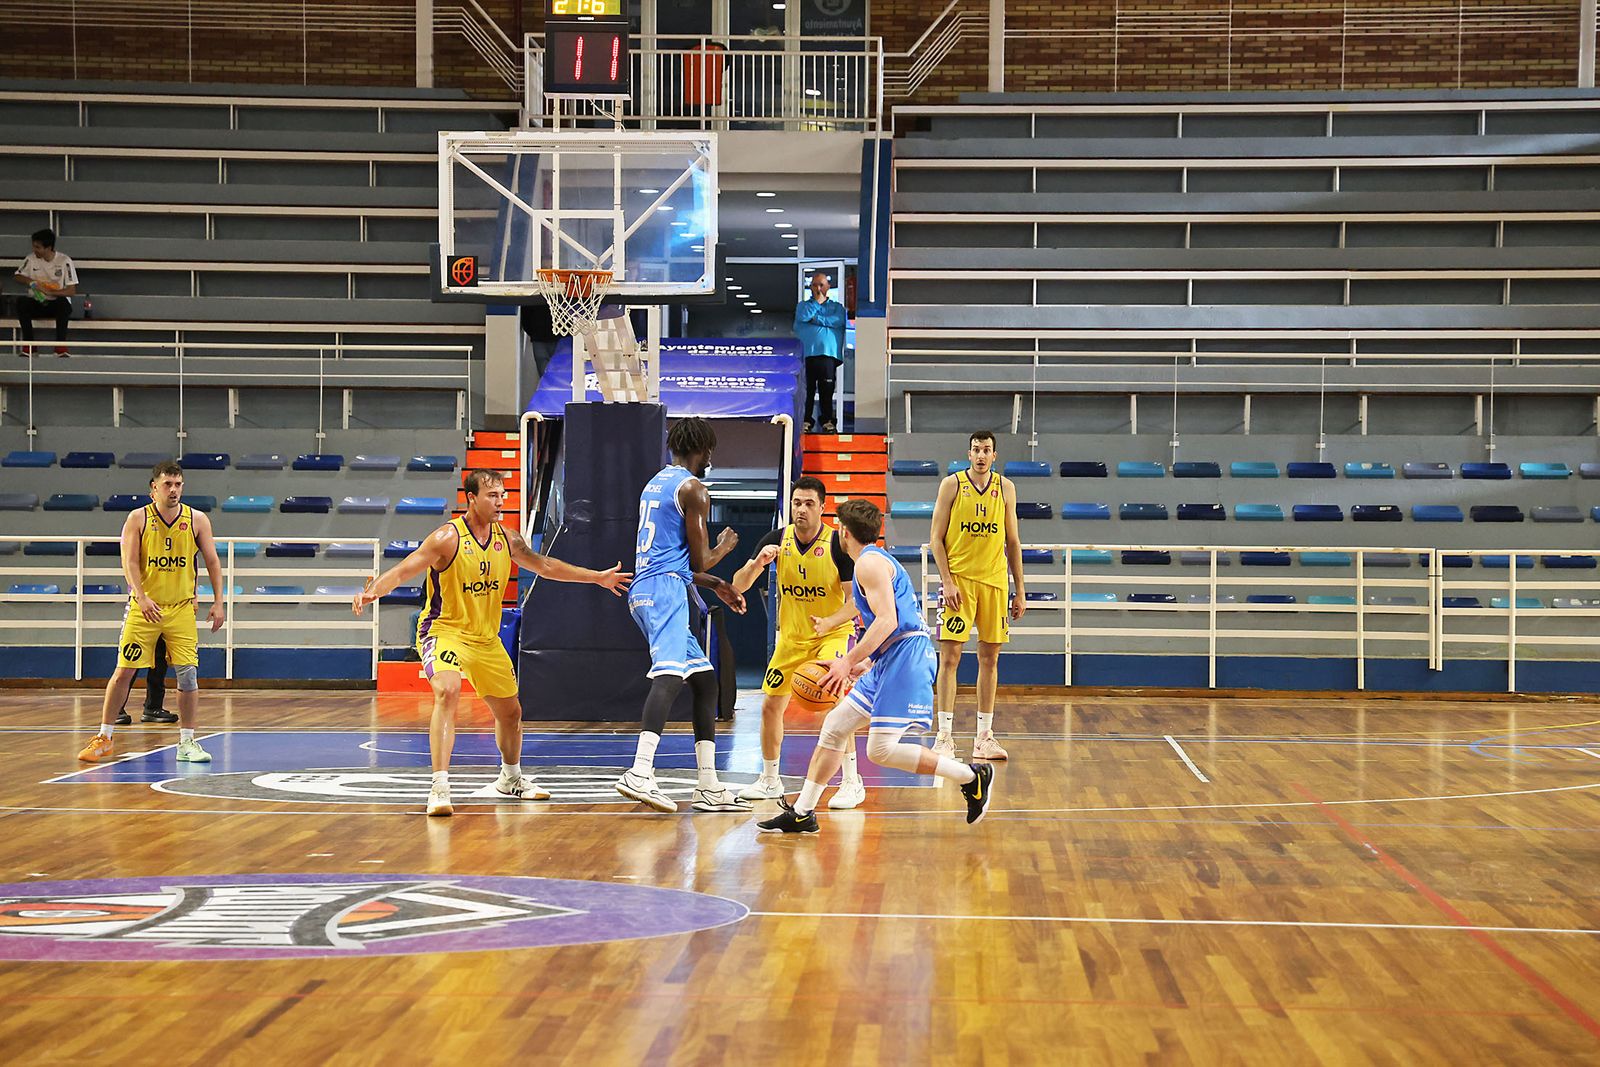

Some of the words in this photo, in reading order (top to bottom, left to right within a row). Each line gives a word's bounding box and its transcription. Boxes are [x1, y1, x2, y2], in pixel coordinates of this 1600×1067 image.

[976, 503, 986, 517] 14
[961, 521, 998, 534] HOMS
[165, 537, 172, 551] 9
[148, 556, 187, 568] HOMS
[480, 561, 491, 576] 91
[798, 564, 806, 580] 4
[782, 584, 826, 598] HOMS
[946, 616, 966, 635] hp
[123, 642, 143, 662] hp
[765, 667, 785, 688] hp
